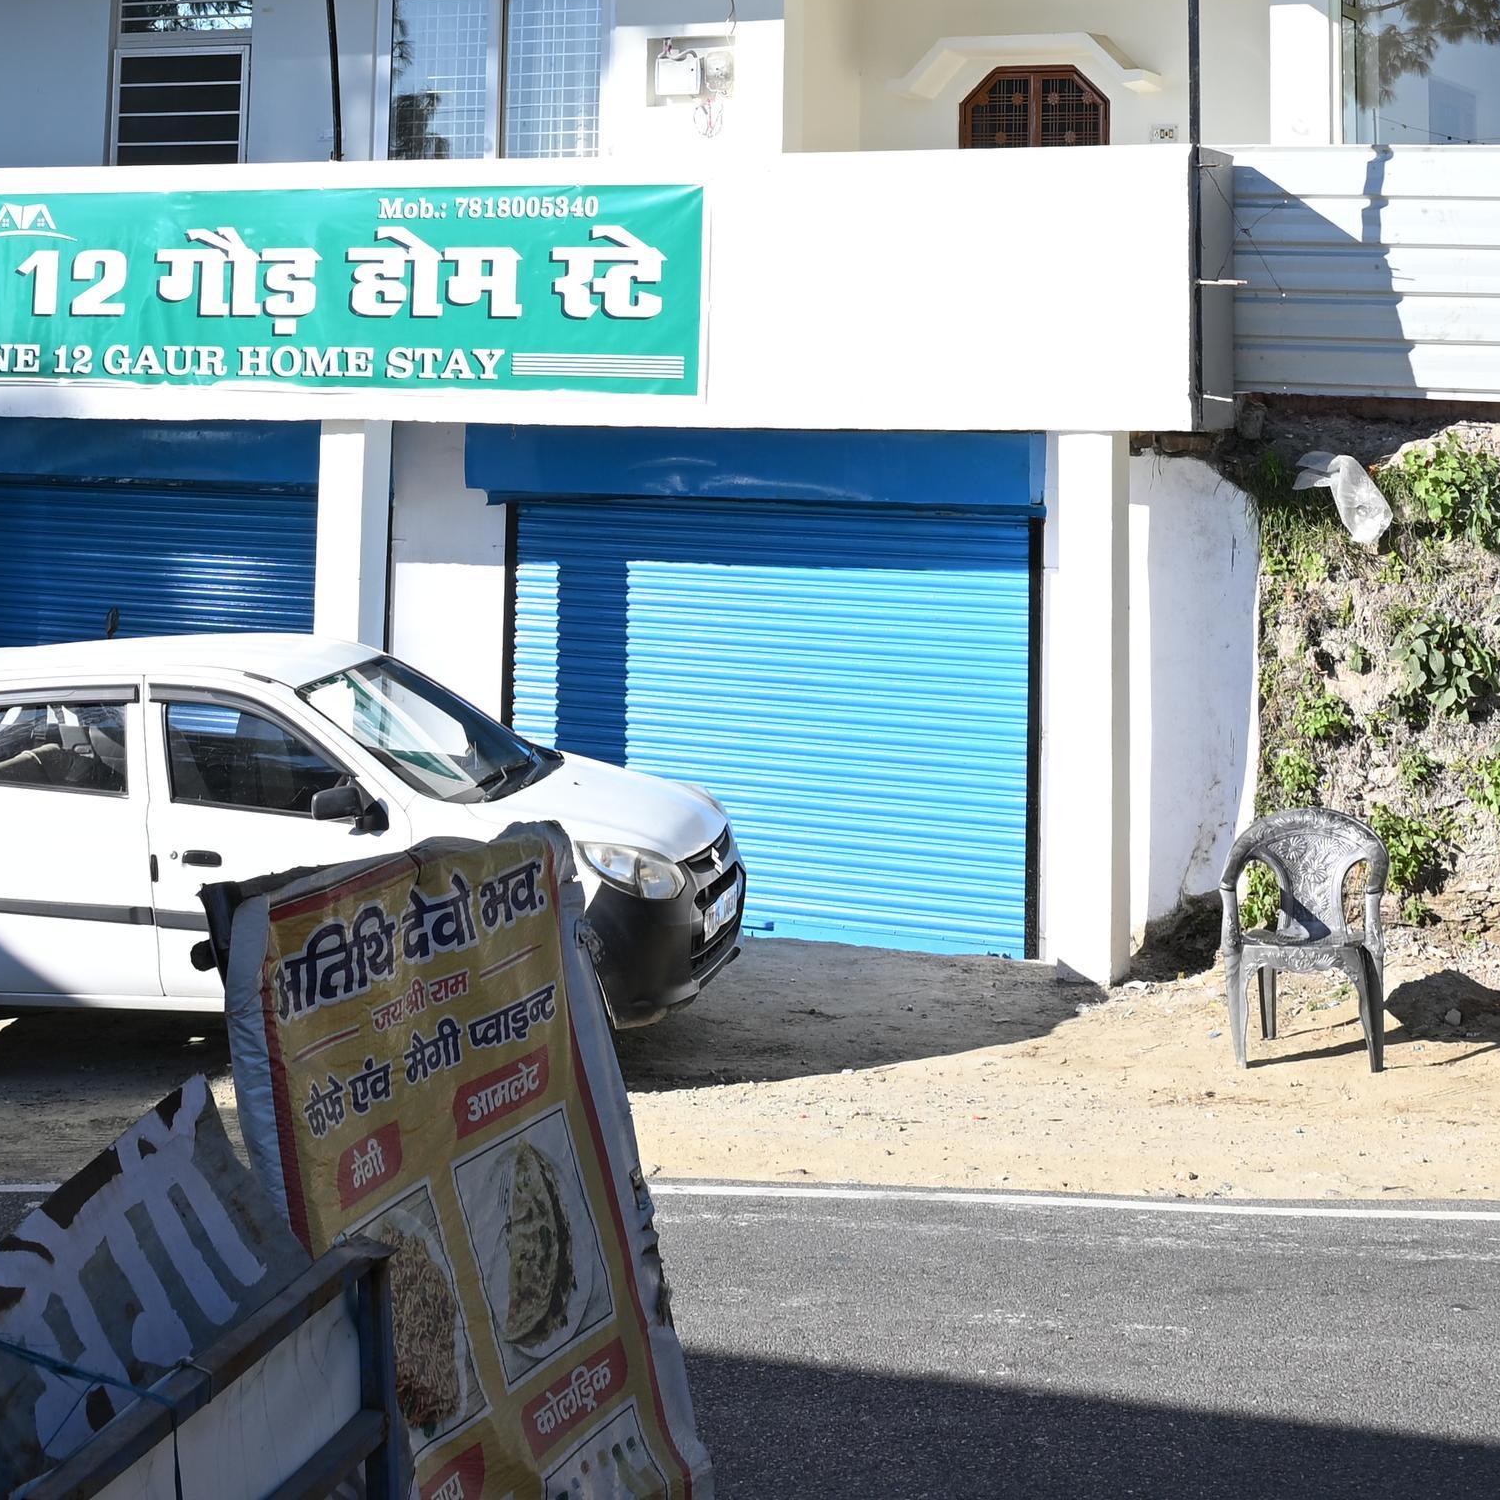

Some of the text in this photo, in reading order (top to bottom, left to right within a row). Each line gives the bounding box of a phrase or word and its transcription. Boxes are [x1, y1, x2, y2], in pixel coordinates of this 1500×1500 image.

[376, 195, 599, 220] Mob.: 7818005340
[14, 248, 128, 317] 12
[155, 226, 323, 336] गौड़
[345, 226, 524, 318] होम
[550, 225, 668, 319] स्टे
[53, 344, 93, 375] 12
[102, 344, 228, 377] GAUR
[236, 345, 374, 378] HOME
[385, 346, 506, 380] STAY
[274, 902, 397, 1022] अतिथि
[401, 870, 478, 962] देवो
[372, 971, 469, 1031] जय श्री राम
[404, 1018, 463, 1084] मैगी
[468, 982, 557, 1048] प्वाइन्ट
[467, 1063, 540, 1122] आमलेट
